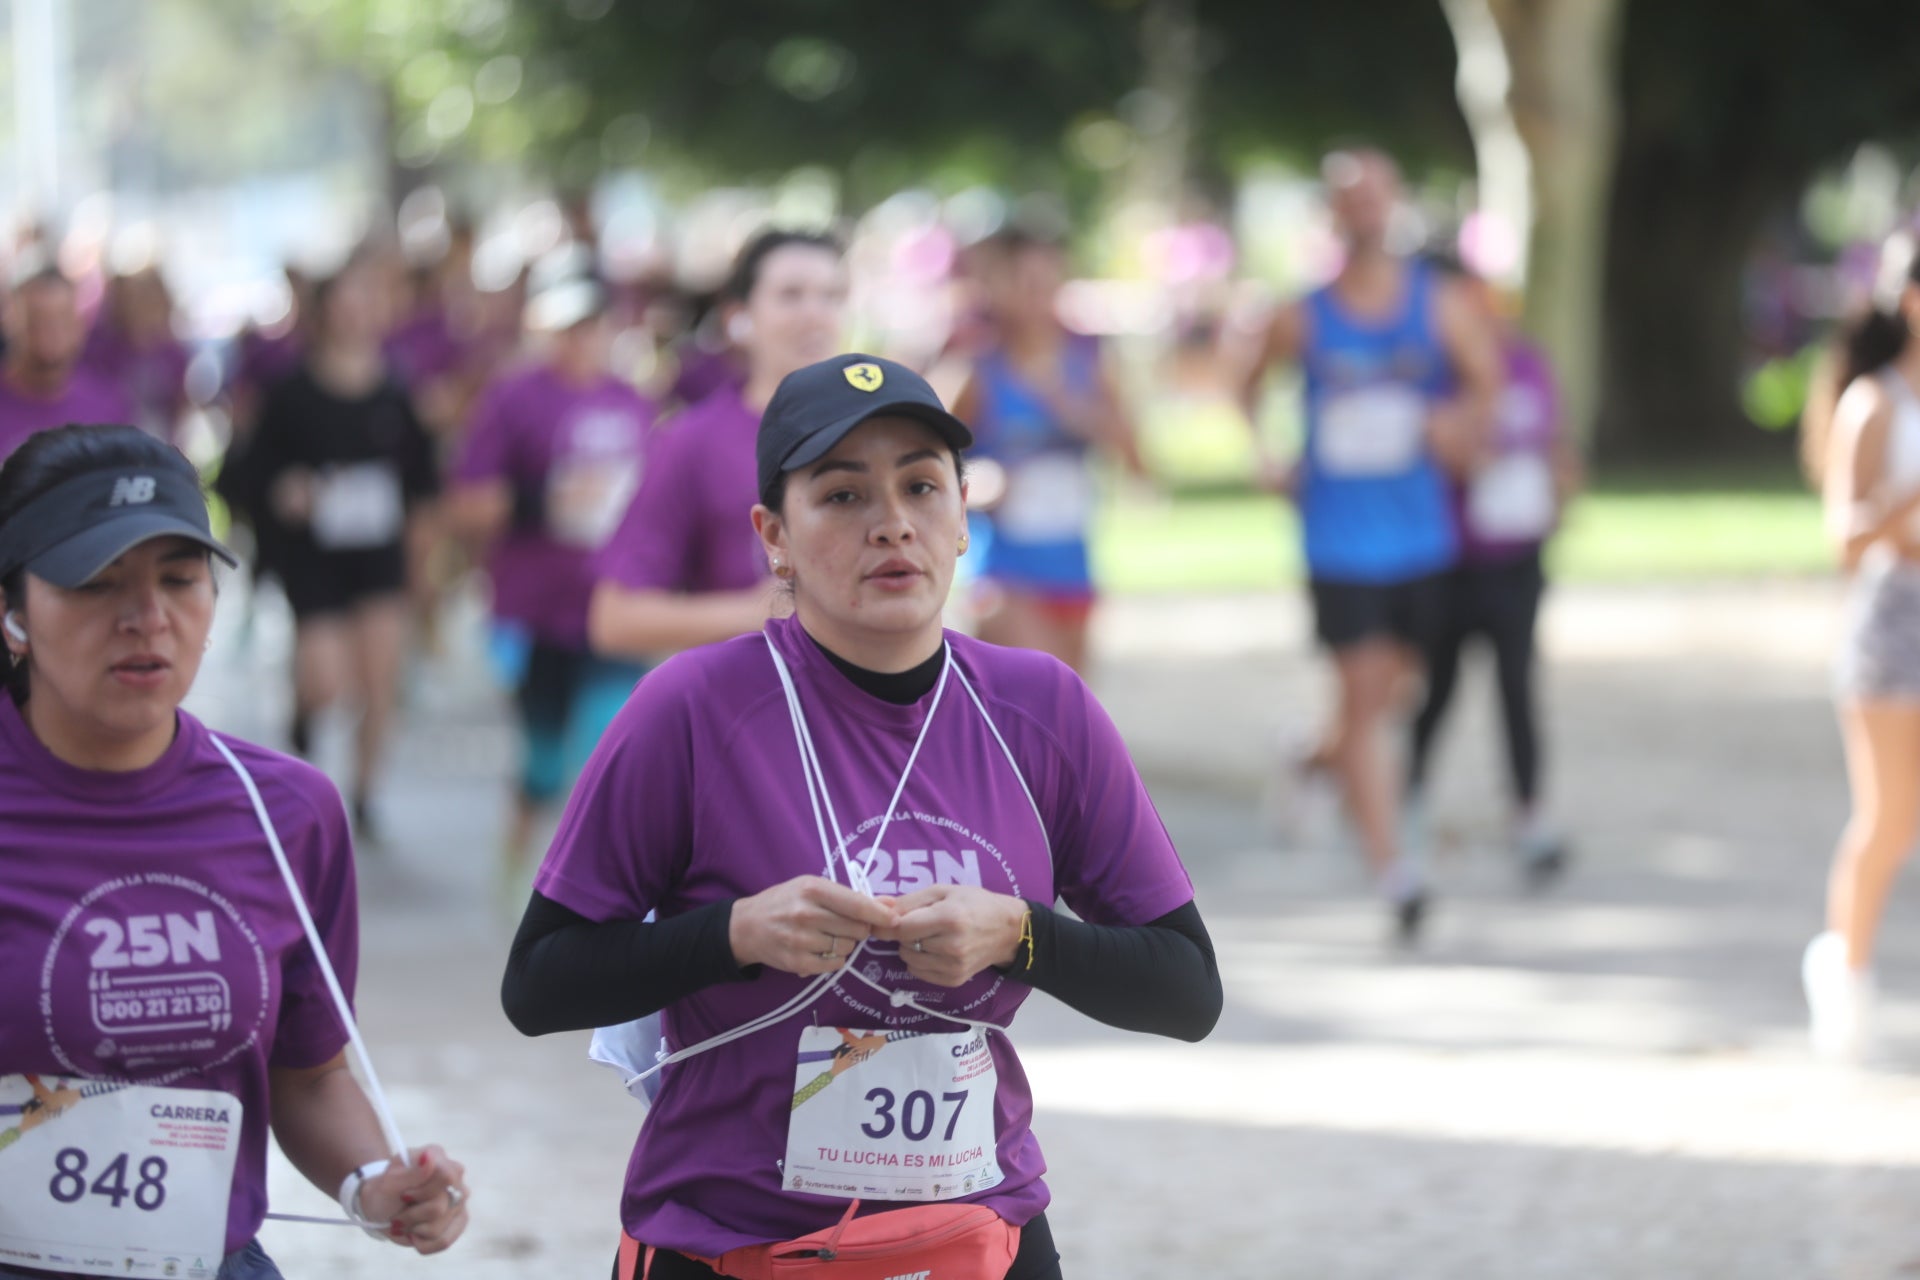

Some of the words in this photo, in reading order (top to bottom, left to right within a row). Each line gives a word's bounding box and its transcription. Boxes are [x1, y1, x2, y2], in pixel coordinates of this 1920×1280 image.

[109, 477, 156, 507] NB
[895, 811, 911, 821] LA
[912, 811, 970, 838] VIOLENCIA
[971, 833, 1002, 862] HACIA
[1001, 860, 1017, 883] LAS
[82, 877, 125, 907] CONTRA
[125, 875, 143, 887] LA
[145, 871, 209, 898] VIOLENCIA
[856, 847, 983, 898] 25N
[84, 911, 221, 969] 25N
[101, 1000, 143, 1020] 900
[146, 997, 168, 1017] 21
[171, 995, 193, 1015] 21
[195, 993, 222, 1013] 30
[843, 994, 883, 1021] CONTRA
[884, 1015, 898, 1025] LA
[150, 1103, 230, 1124] CARRERA
[861, 1087, 969, 1141] 307
[817, 1147, 838, 1162] TU
[843, 1150, 899, 1167] LUCHA
[903, 1154, 924, 1168] ES
[928, 1154, 944, 1168] MI
[948, 1146, 983, 1167] LUCHA
[49, 1147, 168, 1211] 848
